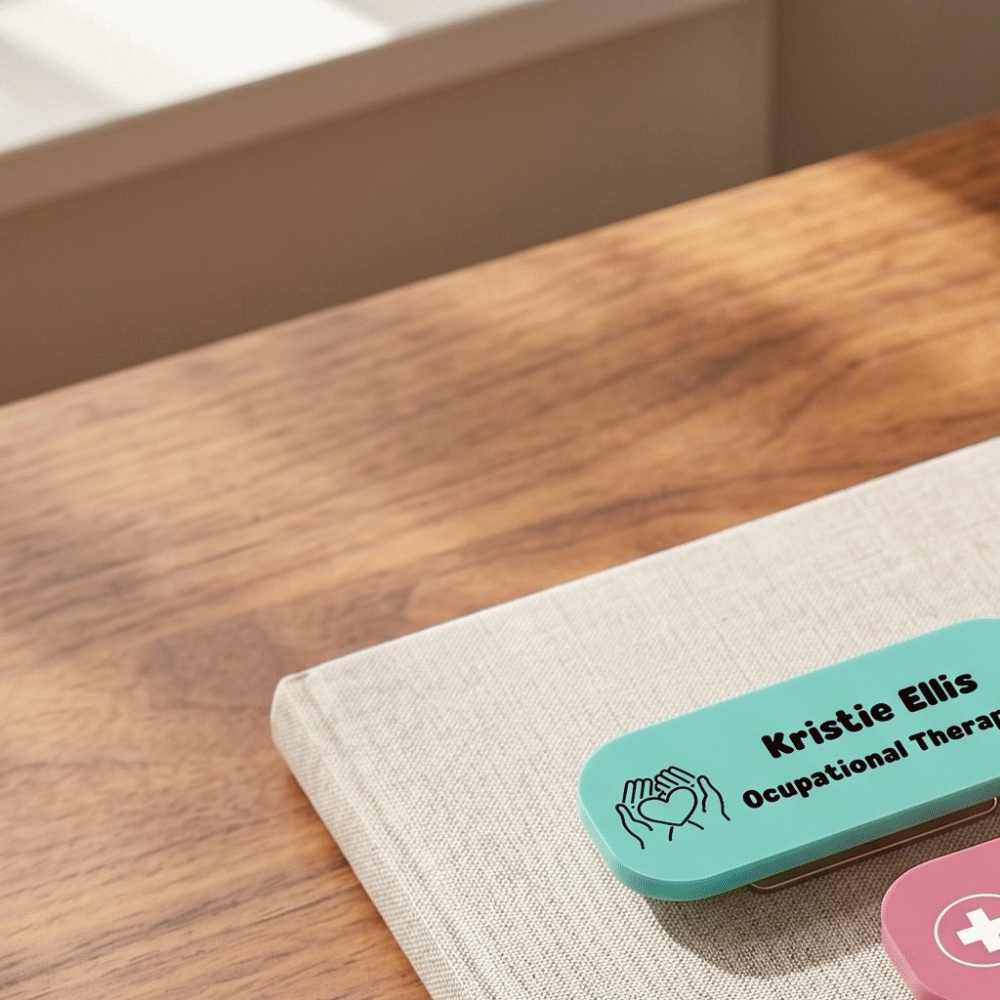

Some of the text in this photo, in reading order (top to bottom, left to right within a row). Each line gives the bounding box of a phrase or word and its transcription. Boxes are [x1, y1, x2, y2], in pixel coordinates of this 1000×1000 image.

[762, 674, 978, 758] Kristie Ellis
[743, 740, 909, 808] Ocupational
